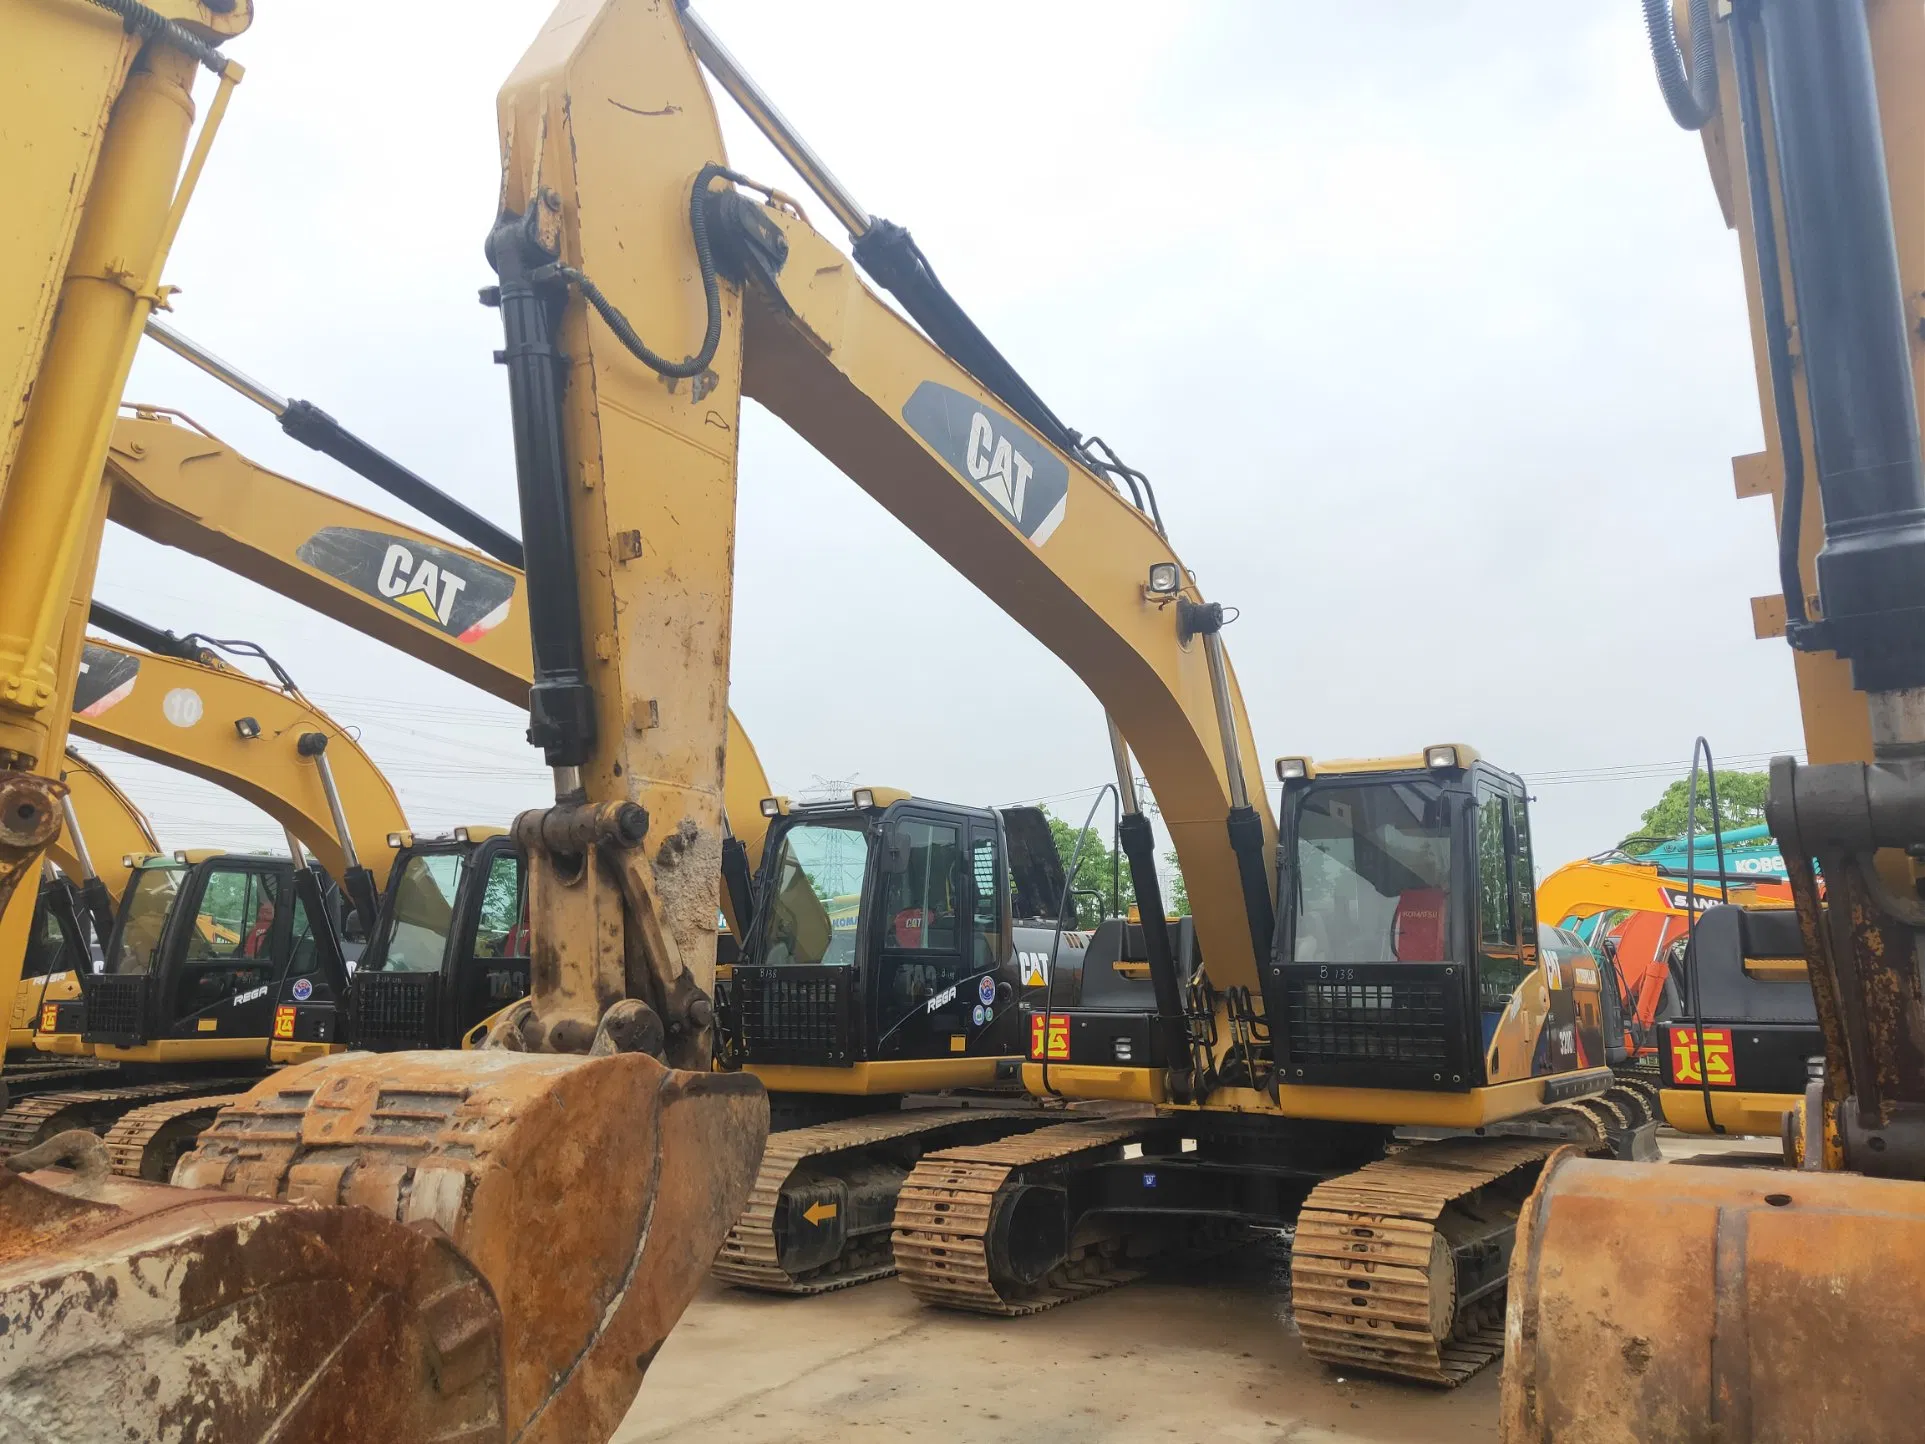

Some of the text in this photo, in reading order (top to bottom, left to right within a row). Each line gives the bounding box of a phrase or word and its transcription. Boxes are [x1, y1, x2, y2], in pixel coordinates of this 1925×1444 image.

[967, 412, 1033, 523] CAT
[378, 544, 467, 626] CAT
[1735, 856, 1787, 873] KOBE
[832, 915, 858, 927] KOM
[905, 918, 922, 928] CAT
[1402, 910, 1438, 919] KOMATSU
[1019, 951, 1049, 987] CAT
[233, 985, 268, 1006] REGA
[926, 986, 957, 1014] REGA
[274, 1007, 294, 1037] 运
[1033, 1016, 1068, 1057] 运
[1673, 1030, 1733, 1083] 运
